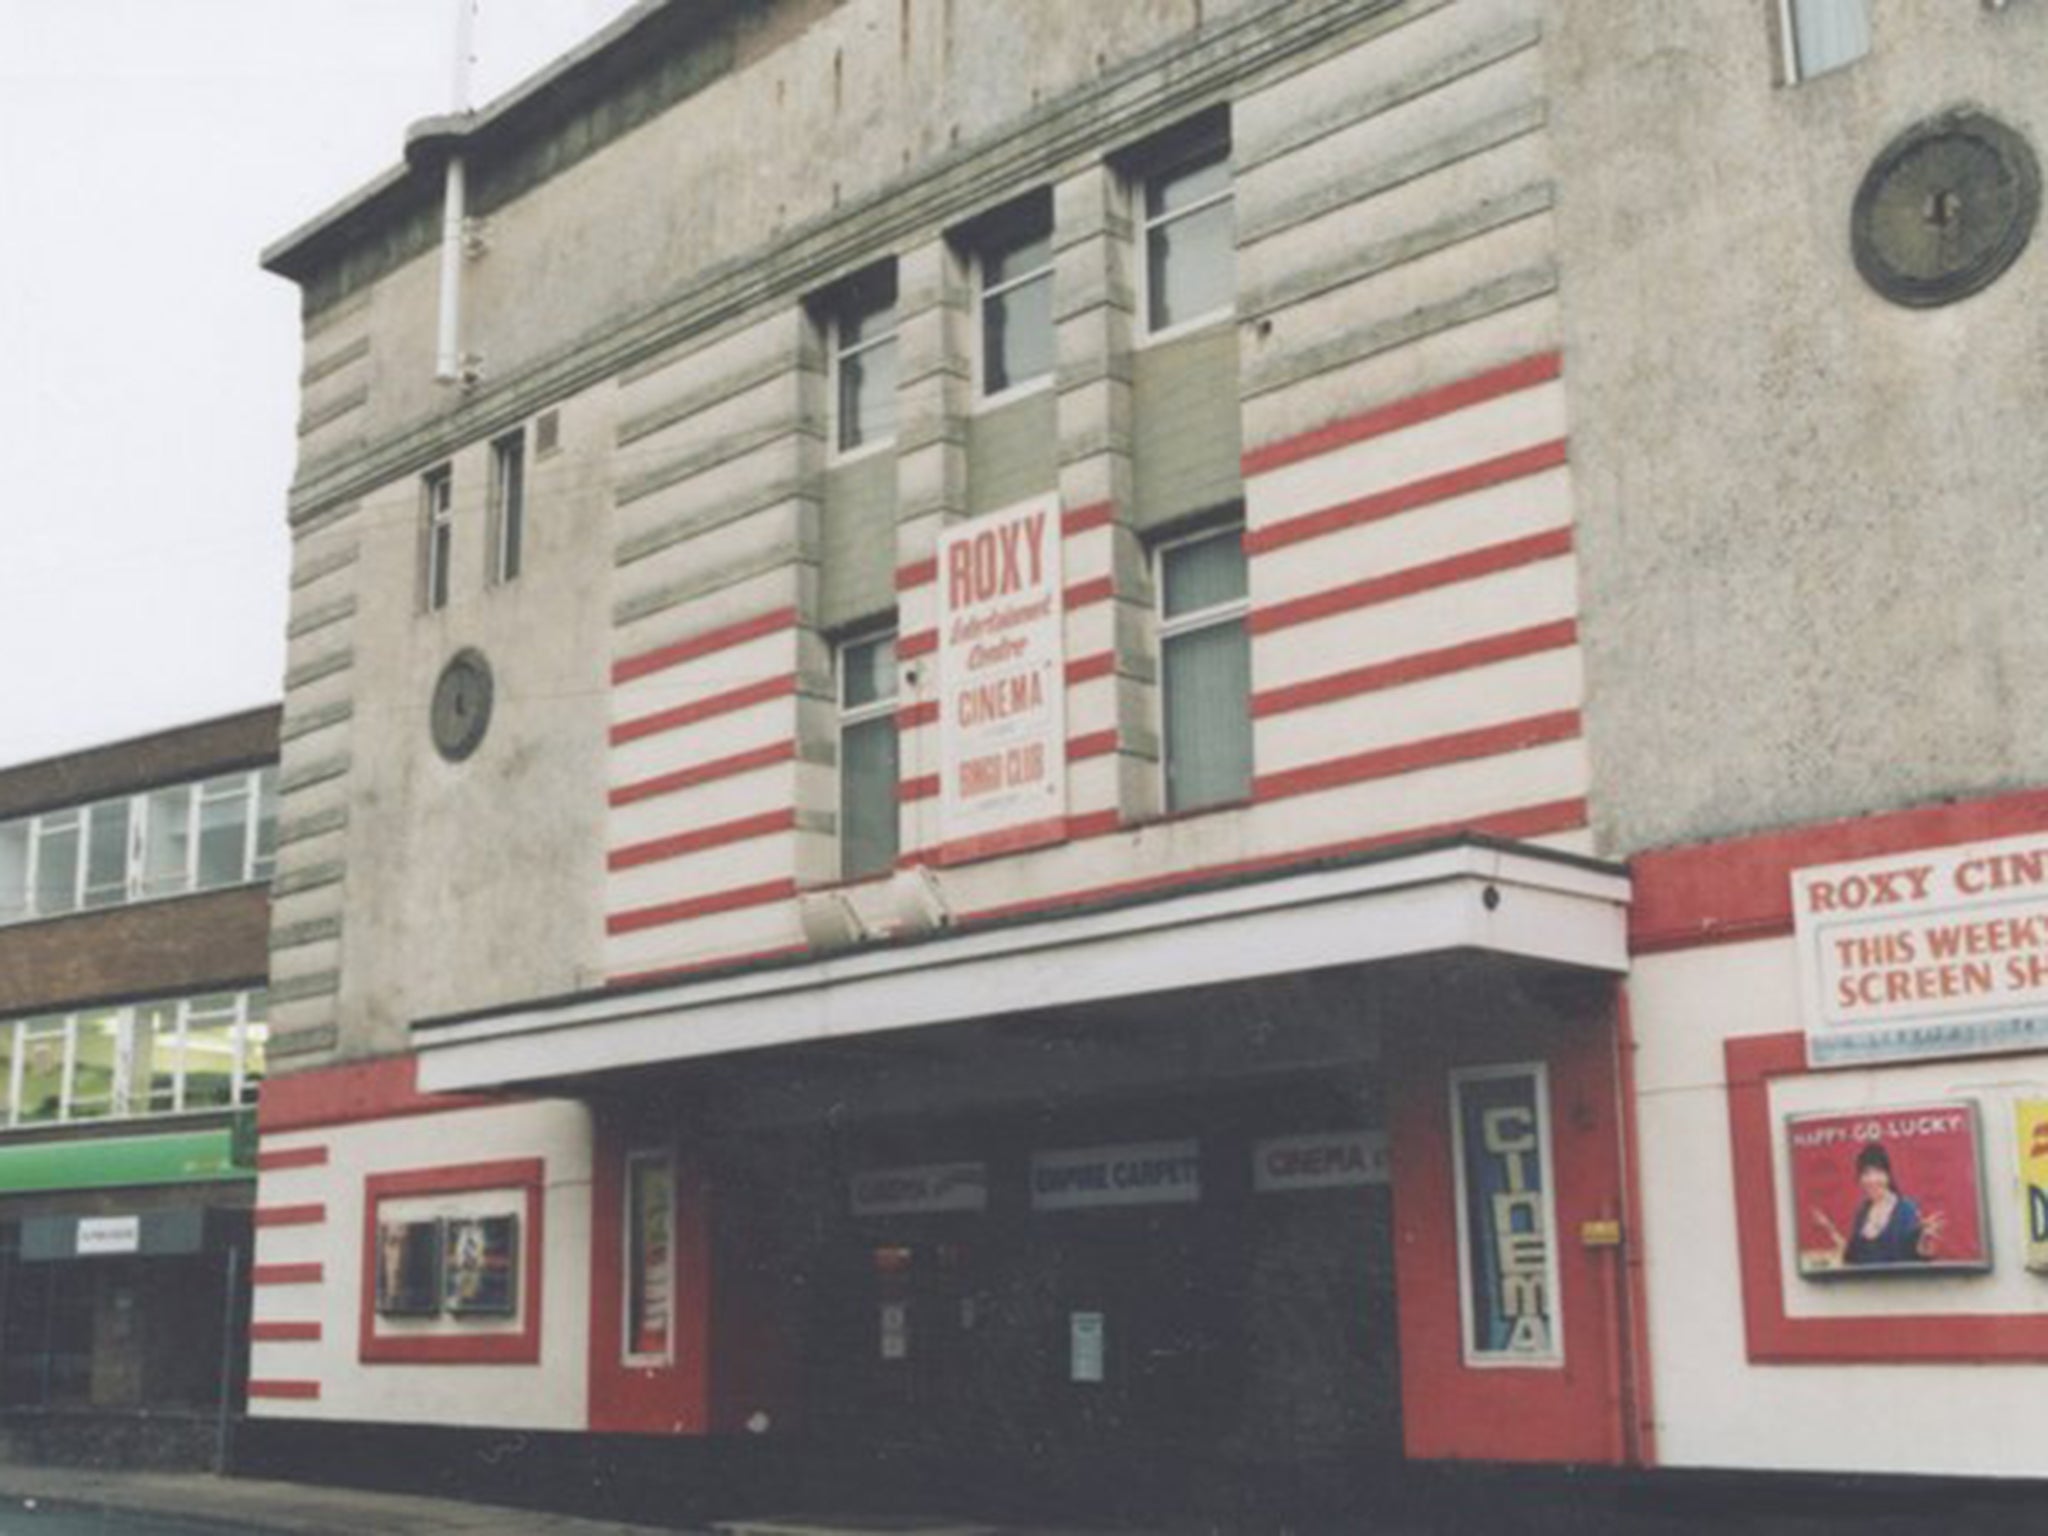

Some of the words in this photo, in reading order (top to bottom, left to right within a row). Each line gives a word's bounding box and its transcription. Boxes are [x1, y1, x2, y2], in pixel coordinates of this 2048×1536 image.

[949, 512, 1046, 610] ROXY
[958, 670, 1044, 729] CINEMA
[1007, 742, 1045, 787] CLUB
[1808, 866, 1934, 912] ROXY
[1835, 930, 1916, 968] THIS
[1838, 963, 1993, 1008] SCREEN
[1483, 1106, 1548, 1352] CINEMA
